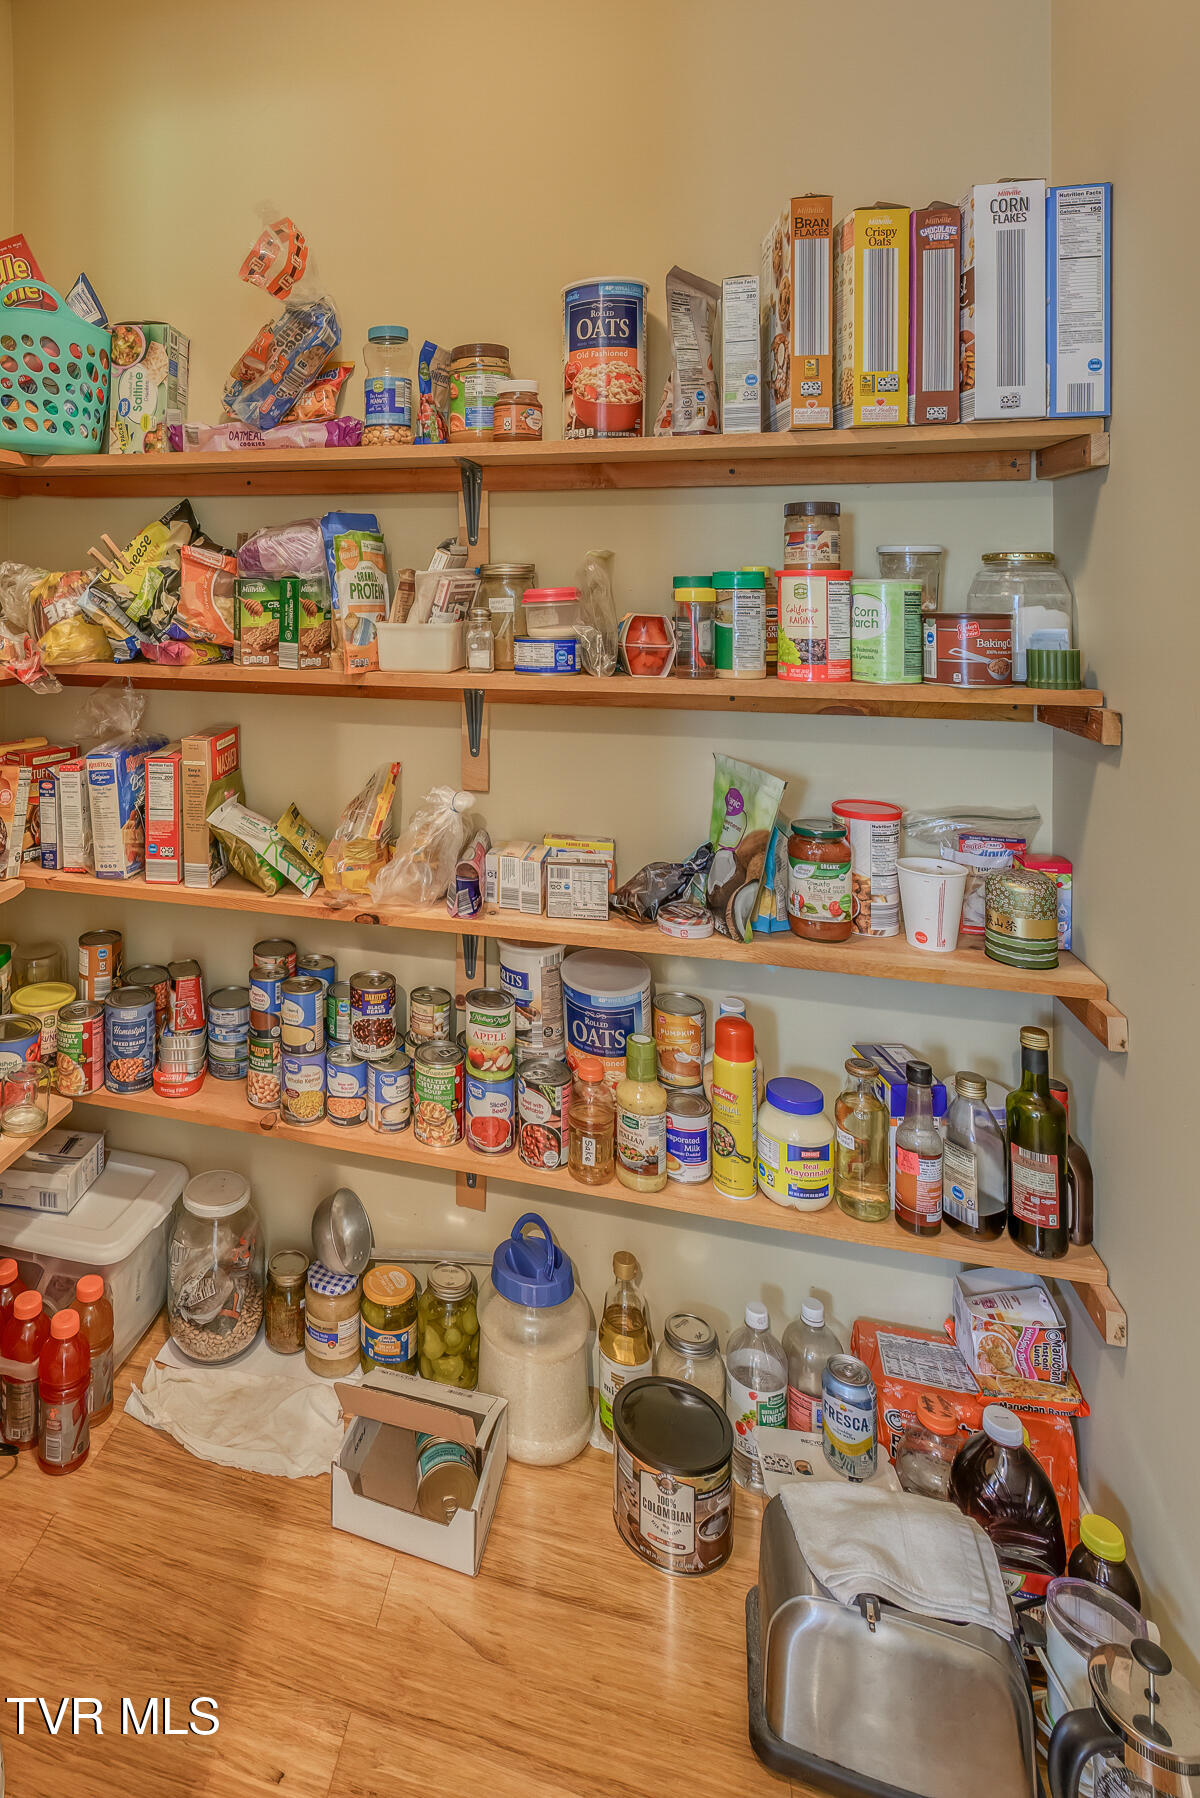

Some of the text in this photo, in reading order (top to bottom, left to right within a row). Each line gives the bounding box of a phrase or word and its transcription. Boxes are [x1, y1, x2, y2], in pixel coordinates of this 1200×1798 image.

[997, 188, 1021, 197] Millville
[990, 196, 1030, 214] CORN
[794, 217, 829, 229] BRAN
[925, 217, 951, 225] Millville
[992, 212, 1027, 225] FLAKES
[794, 228, 829, 237] FLAKES
[865, 227, 898, 239] Crispy
[920, 224, 958, 236] CHOCOLATE
[868, 236, 892, 247] Oats
[928, 232, 949, 241] PUFFS
[576, 318, 630, 340] OATS
[576, 350, 628, 359] Old Fashioned
[132, 371, 144, 412] Saltine
[229, 431, 265, 442] OATMEAL
[241, 585, 266, 593] Millville
[349, 582, 385, 600] PROTEIN
[854, 606, 879, 618] Corn
[789, 616, 815, 625] RAISINS
[976, 638, 1007, 650] Baking
[88, 761, 113, 769] KRUSTEAZ
[216, 747, 237, 776] MASHED
[584, 1017, 609, 1028] ROLLED
[113, 1025, 146, 1036] Homestyle
[473, 1031, 507, 1041] APPLE
[572, 1020, 626, 1049] OATS
[660, 1028, 695, 1037] PUMPKIN
[129, 1039, 145, 1047] BEANS
[416, 1079, 452, 1090] CHUNKY
[418, 1075, 449, 1084] HEALTHY
[423, 1087, 442, 1095] SOUP
[584, 1140, 593, 1162] Sake
[683, 1144, 701, 1152] Milk
[784, 1166, 832, 1179] Mayonnaise
[1034, 1345, 1042, 1367] Lunch
[1050, 1339, 1062, 1382] Maruchan
[1000, 1402, 1045, 1414] Maruchan
[823, 1399, 869, 1433] FRESCA
[656, 1494, 677, 1509] 100%
[642, 1496, 692, 1524] COLOMBIAN
